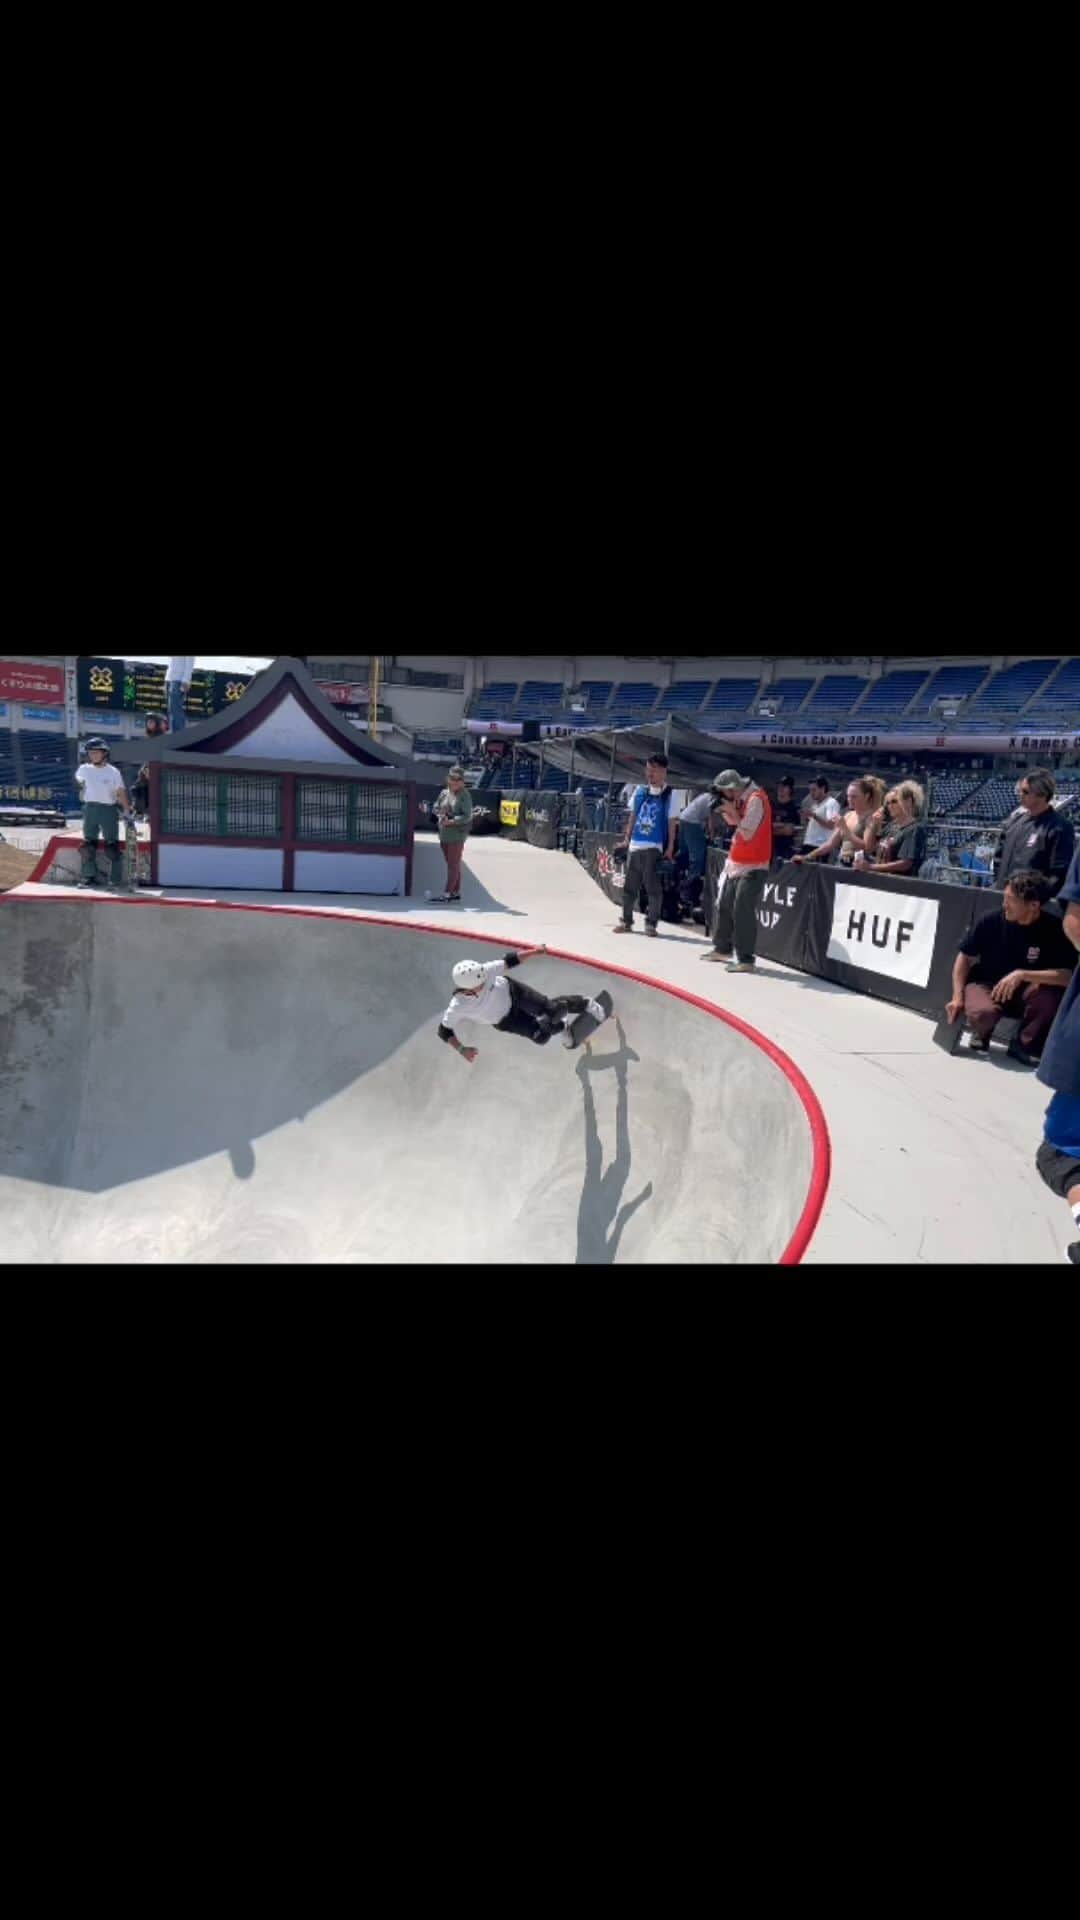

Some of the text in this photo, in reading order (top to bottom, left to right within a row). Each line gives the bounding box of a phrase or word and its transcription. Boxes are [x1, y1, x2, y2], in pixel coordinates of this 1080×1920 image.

[760, 734, 767, 745] X
[770, 734, 807, 745] Games
[848, 735, 878, 746] 2023
[1008, 736, 1017, 752] X
[1021, 737, 1068, 751] Games
[762, 882, 798, 907] YLE
[755, 907, 781, 929] UP
[846, 909, 915, 953] HUF
